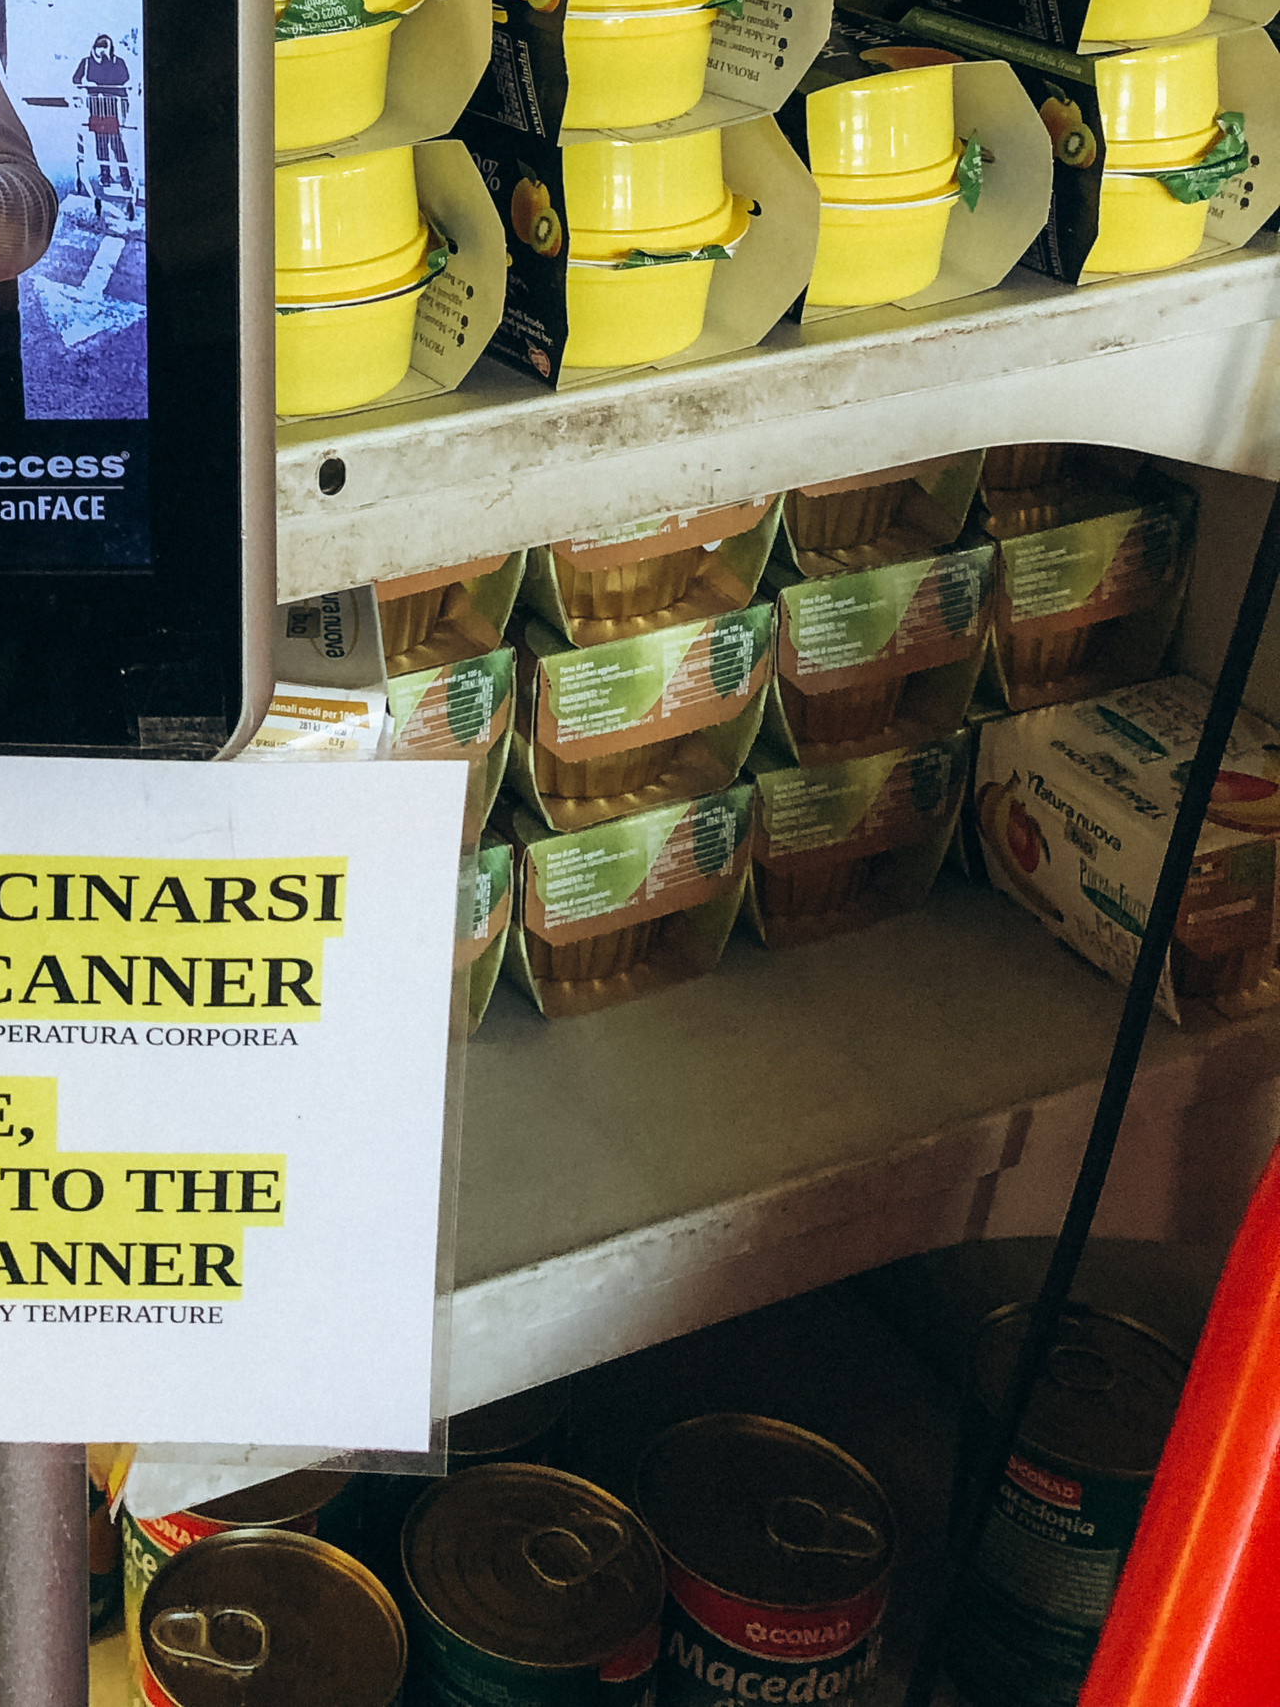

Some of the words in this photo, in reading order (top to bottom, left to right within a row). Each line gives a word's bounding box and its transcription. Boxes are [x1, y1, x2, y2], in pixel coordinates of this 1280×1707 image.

[727, 63, 760, 81] PROVA
[518, 40, 545, 137] www.melinda.it
[322, 615, 345, 658] nuova
[298, 704, 321, 718] medi
[322, 708, 338, 722] per
[1077, 813, 1122, 852] nuova
[146, 1028, 297, 1045] CORPOREA
[0, 1168, 103, 1211] TO
[126, 1170, 280, 1212] THE
[24, 1306, 222, 1323] TEMPERATURE
